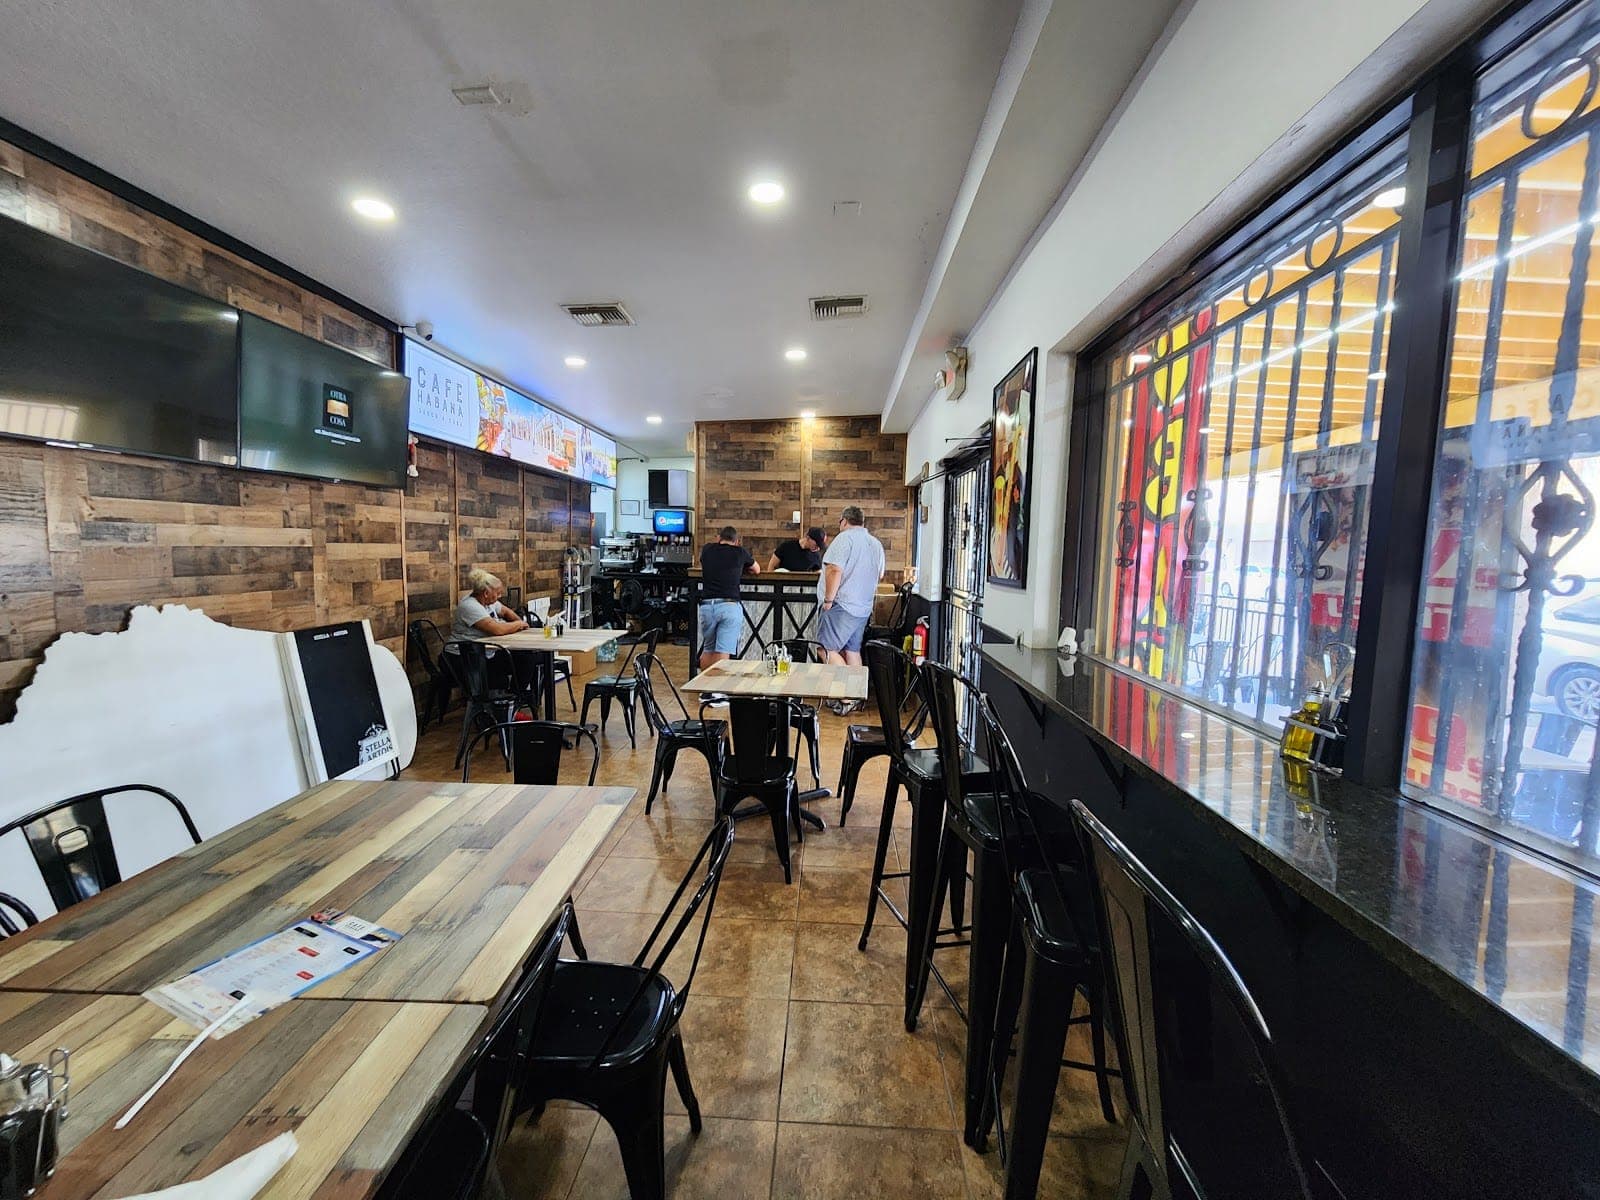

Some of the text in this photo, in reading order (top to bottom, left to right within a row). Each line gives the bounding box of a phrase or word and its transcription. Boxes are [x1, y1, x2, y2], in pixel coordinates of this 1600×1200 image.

[417, 366, 463, 403] CAFE
[417, 389, 464, 418] HABANA
[365, 736, 391, 754] STELLA
[367, 743, 393, 762] ARTOIS
